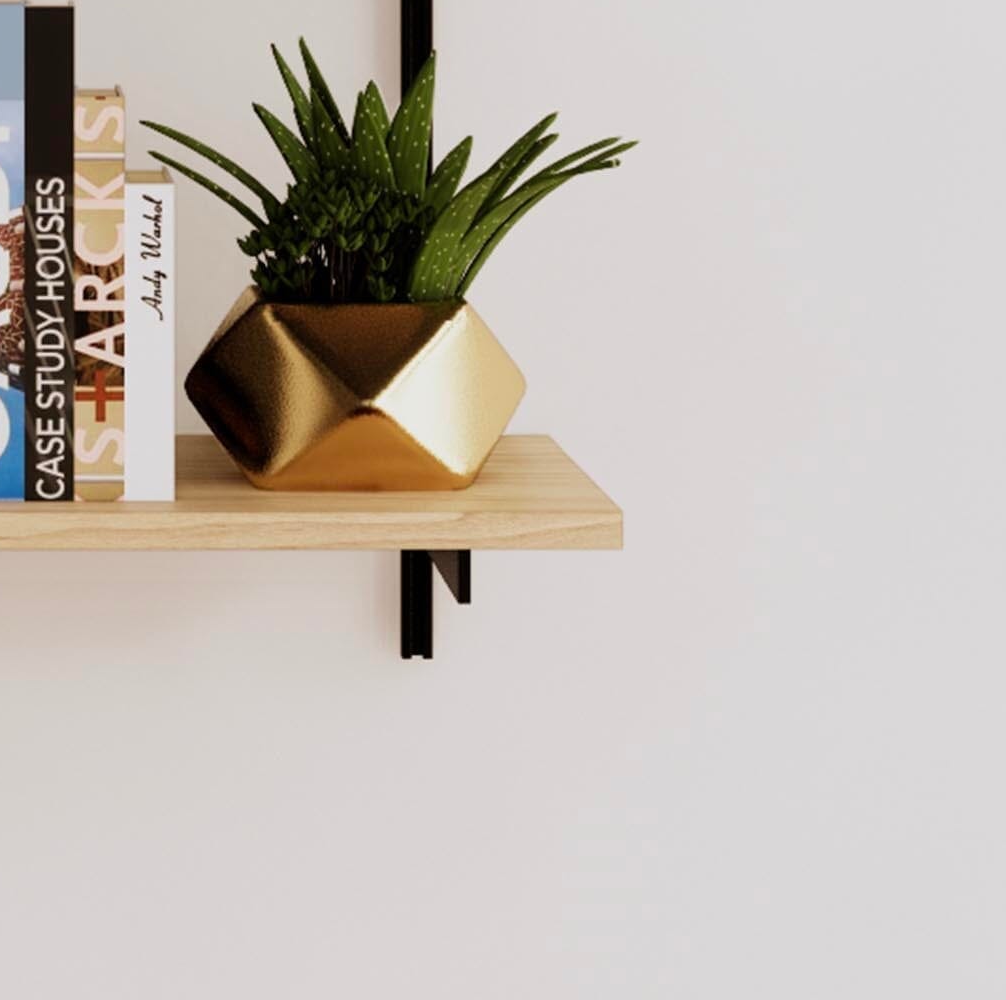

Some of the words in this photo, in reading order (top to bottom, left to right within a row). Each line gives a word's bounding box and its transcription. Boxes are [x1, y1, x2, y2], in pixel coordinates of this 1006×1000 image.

[35, 176, 65, 301] HOUSES
[140, 194, 163, 260] Warhol
[140, 270, 167, 322] Andy
[35, 310, 65, 410] STUDY
[35, 418, 65, 500] CASE
